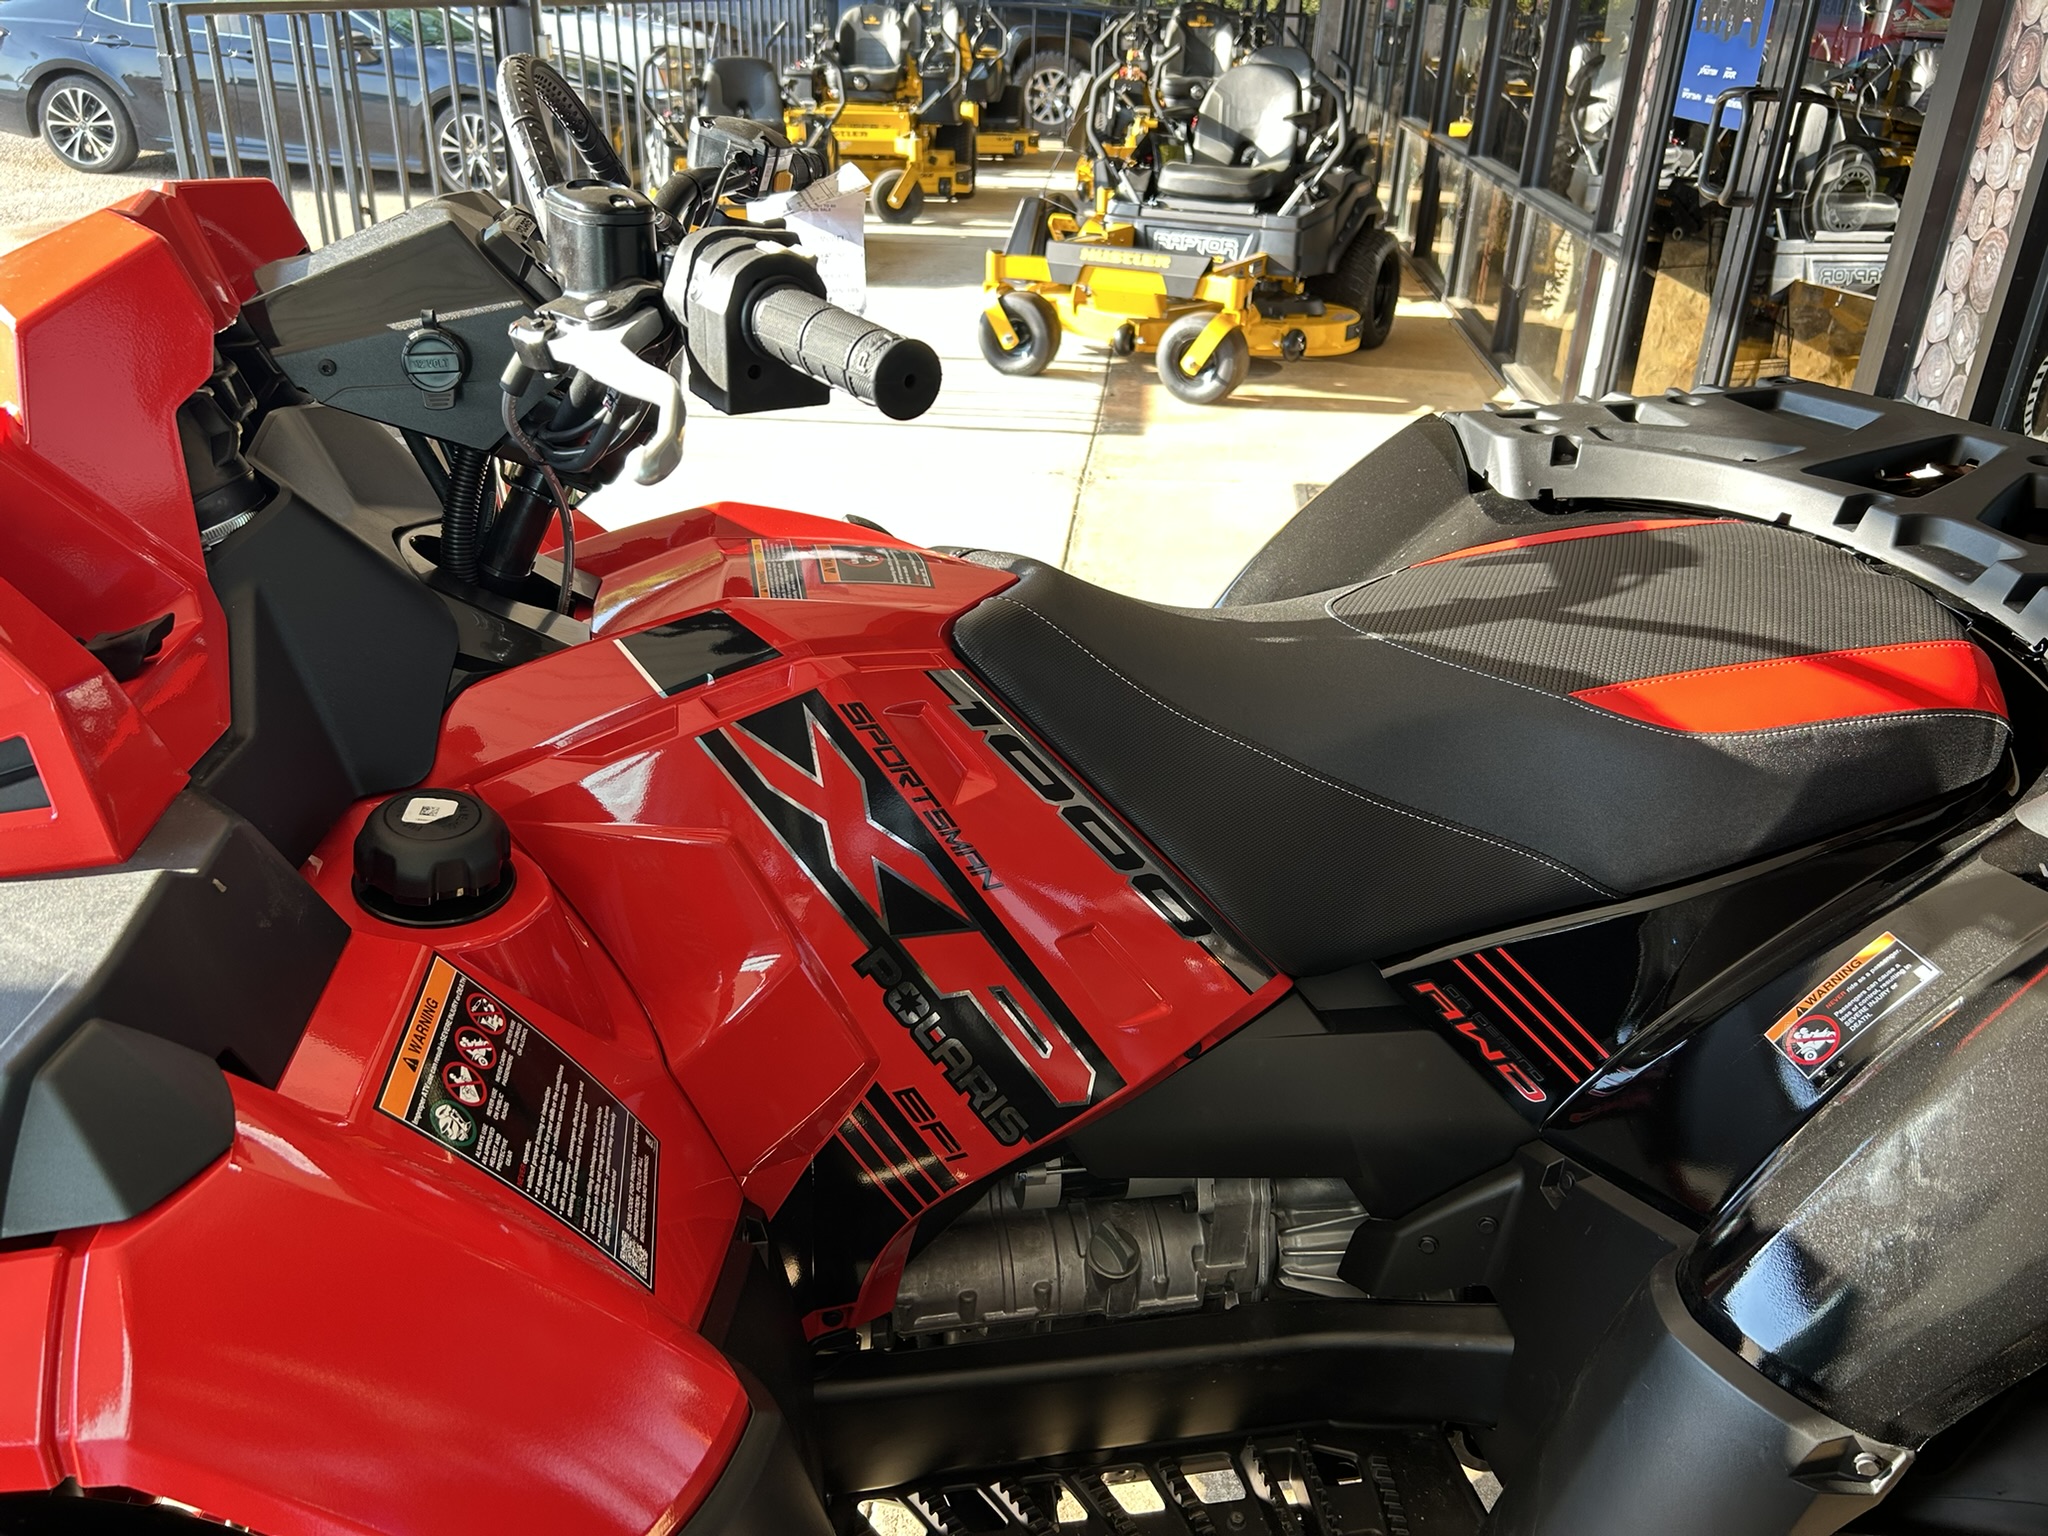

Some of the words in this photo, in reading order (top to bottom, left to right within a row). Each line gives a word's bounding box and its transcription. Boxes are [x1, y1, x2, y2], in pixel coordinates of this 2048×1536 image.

[1079, 248, 1172, 269] HUSTLER
[1153, 230, 1240, 261] RAPTOR
[426, 358, 449, 369] VOLT
[837, 700, 1004, 892] SPORTSMAN
[954, 700, 1215, 939] 1000
[714, 702, 1098, 1108] XP
[1804, 959, 1862, 1005] WARNING
[1825, 991, 1847, 1009] NEVER
[1846, 982, 1858, 992] ride
[1870, 949, 1901, 974] passenger.
[1833, 990, 1867, 1017] Passengers
[1866, 981, 1878, 991] can
[1877, 967, 1895, 982] cause
[1838, 1011, 1852, 1022] loss
[1858, 988, 1881, 1006] control,
[1879, 968, 1906, 989] resulting
[1844, 1006, 1869, 1026] SEVERE
[1867, 988, 1890, 1008] INJURY
[1849, 1013, 1873, 1031] DEATH.
[852, 945, 1031, 1147] POLARIS
[1411, 981, 1548, 1103] AWD
[891, 1086, 969, 1163] EFI
